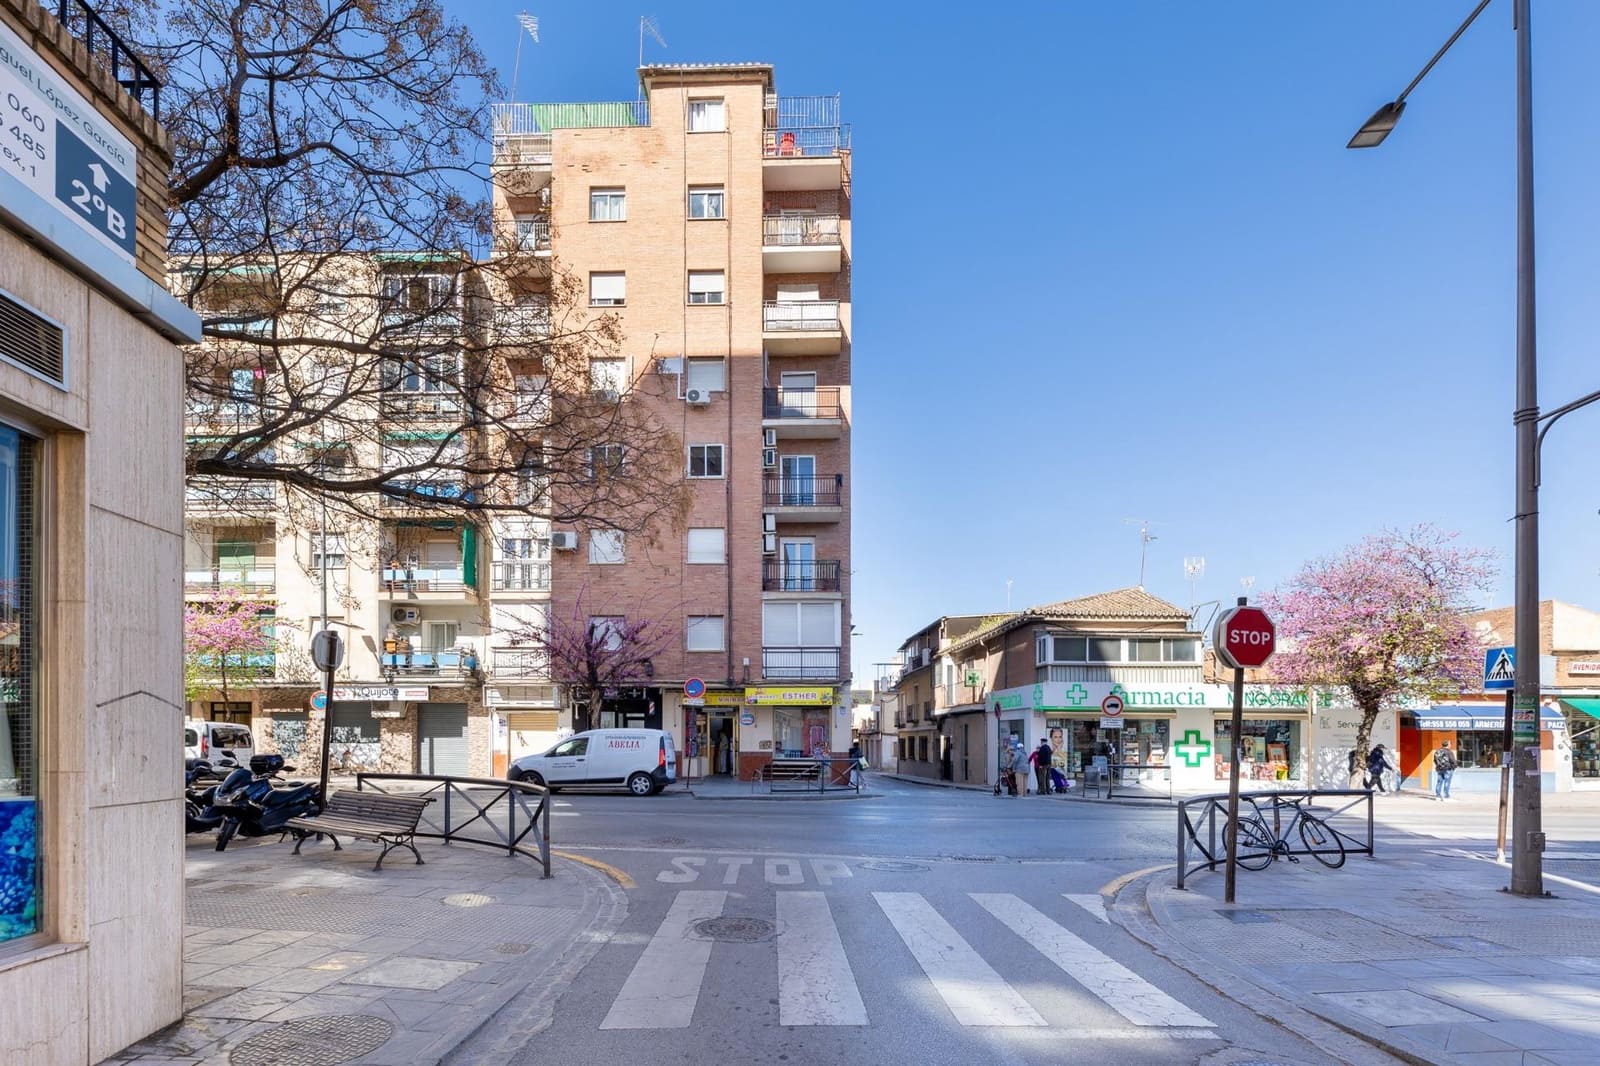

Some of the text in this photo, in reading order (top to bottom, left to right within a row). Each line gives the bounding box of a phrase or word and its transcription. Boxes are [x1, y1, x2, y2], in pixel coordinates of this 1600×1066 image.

[7, 93, 45, 132] 060
[37, 79, 80, 124] López
[83, 121, 125, 165] García
[9, 126, 45, 160] 485
[1230, 629, 1270, 645] STOP
[361, 687, 399, 698] Quijote
[782, 692, 817, 700] ESTHER
[1111, 685, 1206, 705] farmacia
[656, 857, 853, 885] STOP
